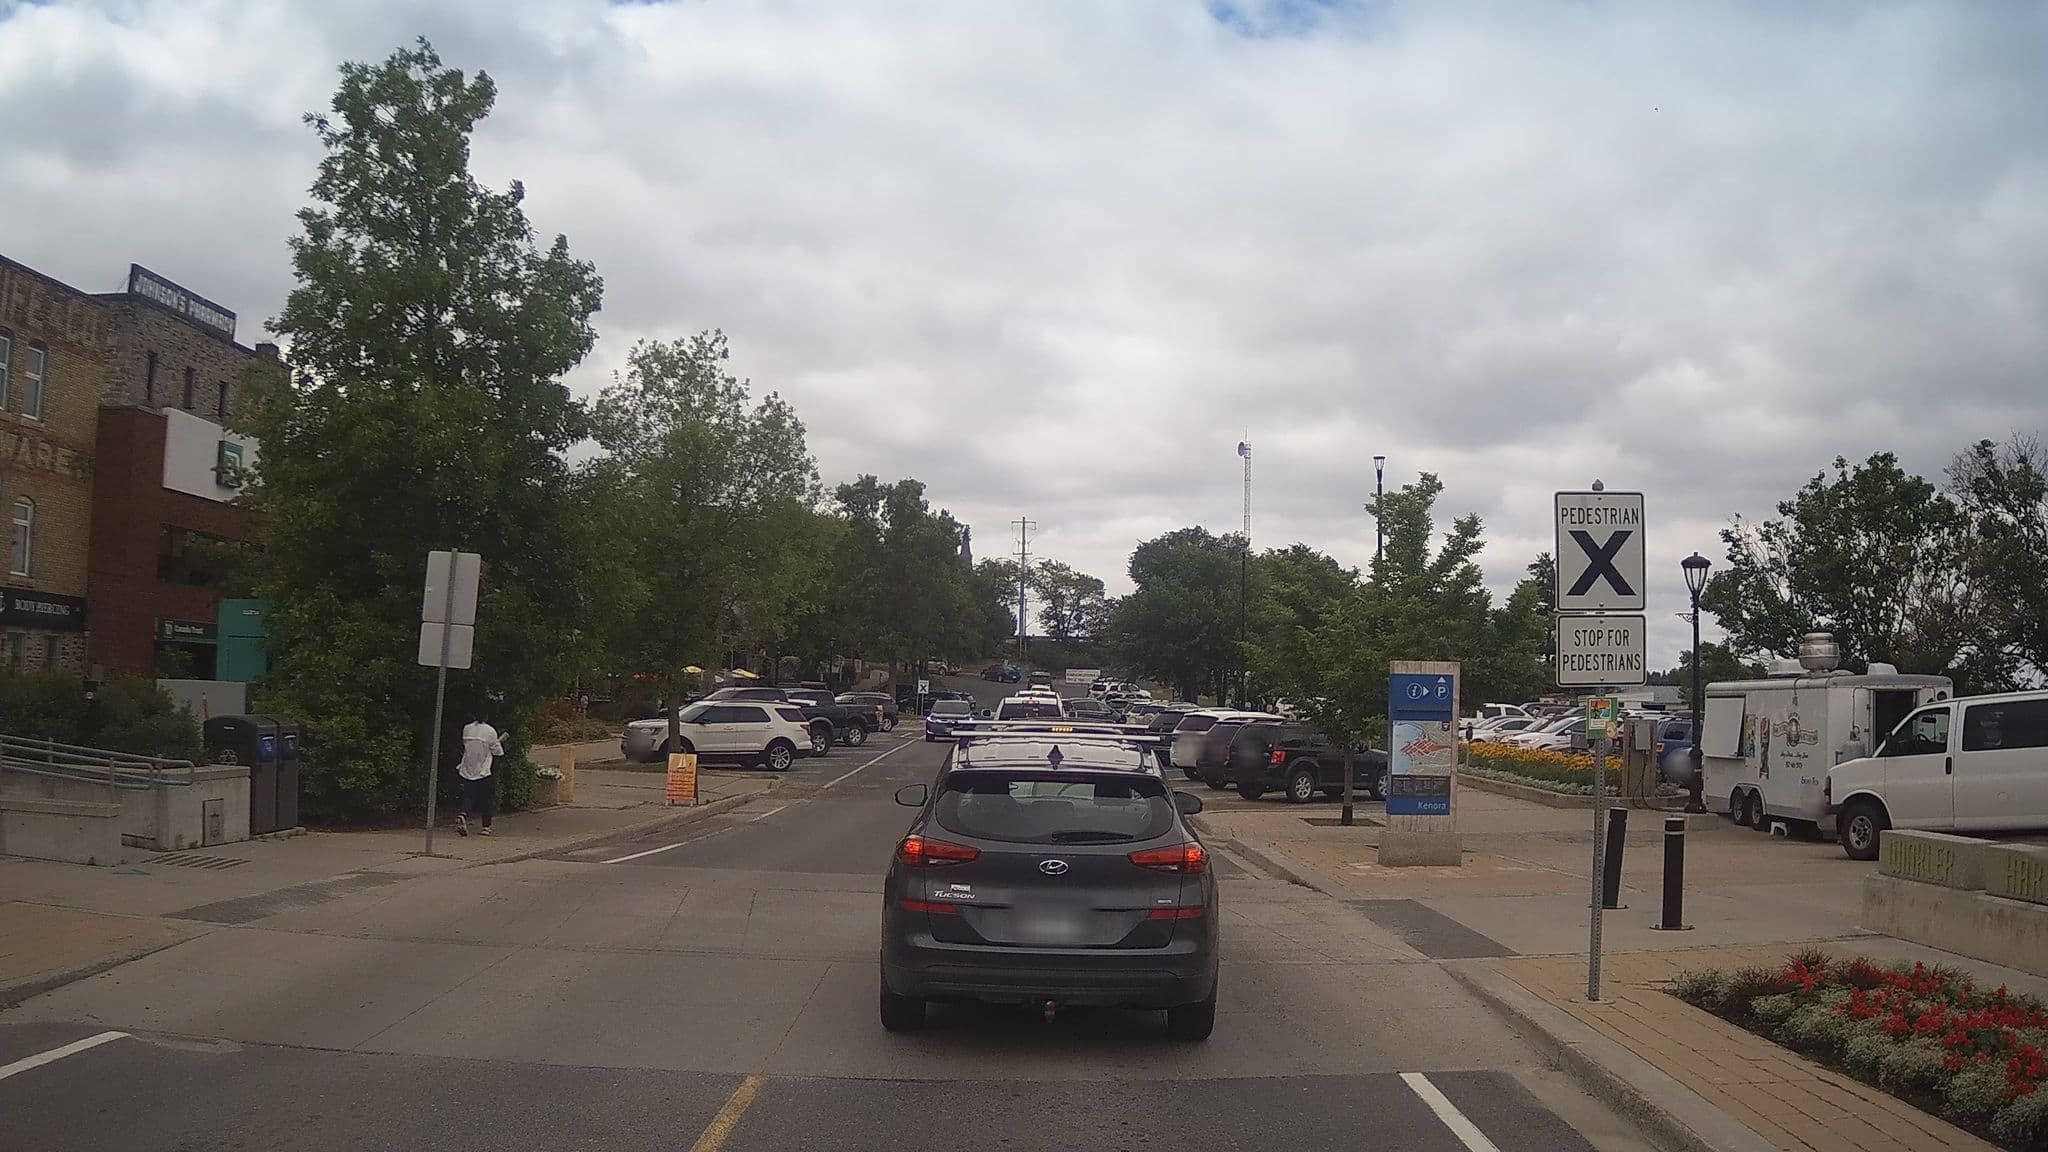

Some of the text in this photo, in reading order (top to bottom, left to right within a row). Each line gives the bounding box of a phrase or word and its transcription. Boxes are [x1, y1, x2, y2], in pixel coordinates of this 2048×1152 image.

[134, 273, 187, 314] JOHNSON'S
[1561, 507, 1640, 525] PEDESTRIAN
[14, 599, 71, 615] BODY PIERCING
[1574, 629, 1630, 647] STOP FOR
[1562, 654, 1641, 672] PEDESTRIANS
[1418, 801, 1447, 811] Kenora
[934, 890, 976, 900] TUCSON
